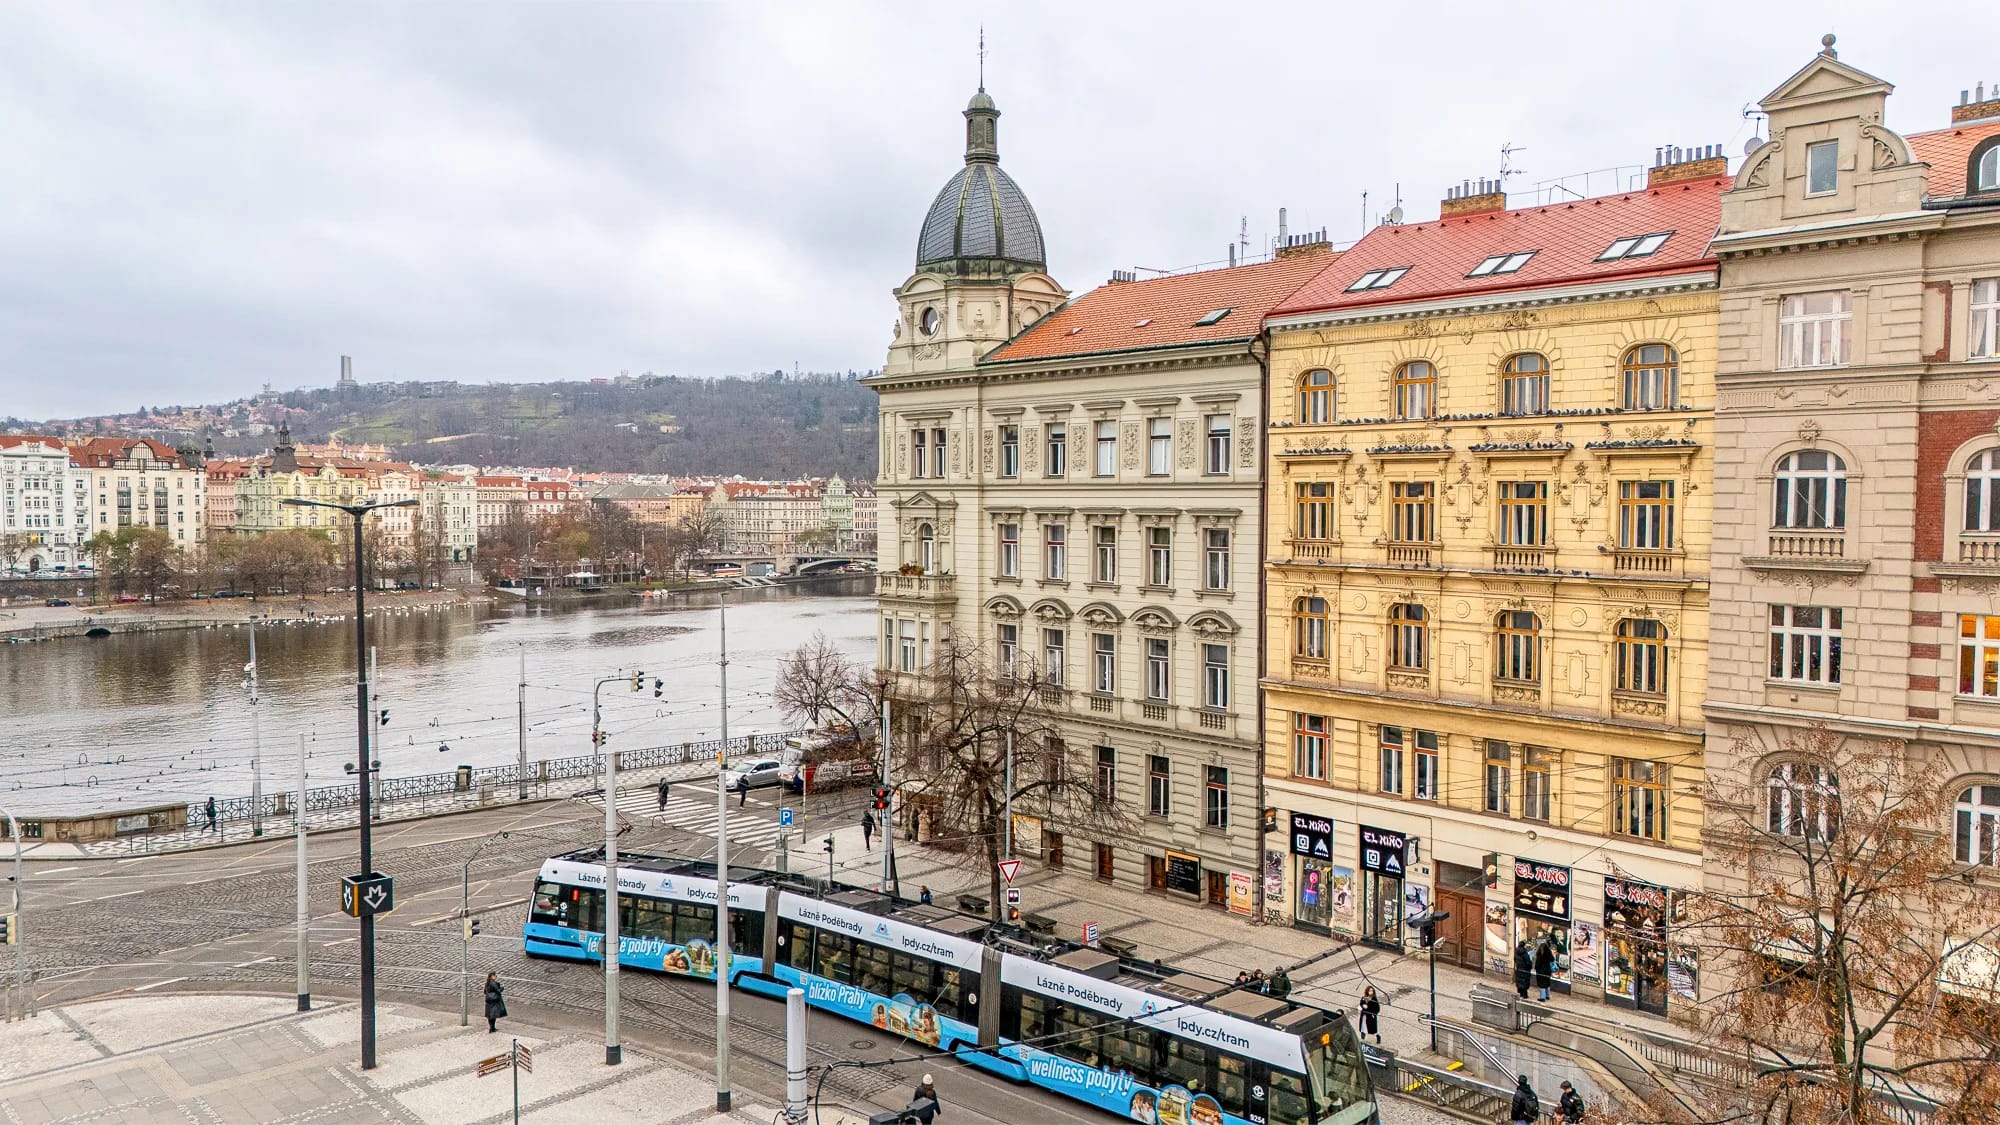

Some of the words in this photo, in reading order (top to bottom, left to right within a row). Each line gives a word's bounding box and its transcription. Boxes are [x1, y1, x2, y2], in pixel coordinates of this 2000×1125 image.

[1294, 816, 1308, 829] EL
[1363, 831, 1378, 844] EL
[578, 872, 601, 884] Lázně
[1515, 862, 1534, 879] EL
[1535, 866, 1568, 886] NIÑO
[1605, 882, 1627, 899] EL
[798, 907, 821, 922] Lázně
[821, 915, 863, 935] Poděbrady
[627, 935, 666, 956] pobyty
[902, 935, 954, 959] lpdy.cz/tram
[808, 979, 837, 1003] blízko
[838, 984, 868, 1010] Prahy
[1036, 975, 1065, 994] Lázně
[1067, 984, 1123, 1012] Poděbrady
[1177, 1017, 1250, 1049] lpdy.cz/tram
[1031, 1057, 1084, 1087] wellness
[1085, 1064, 1135, 1096] pobyty
